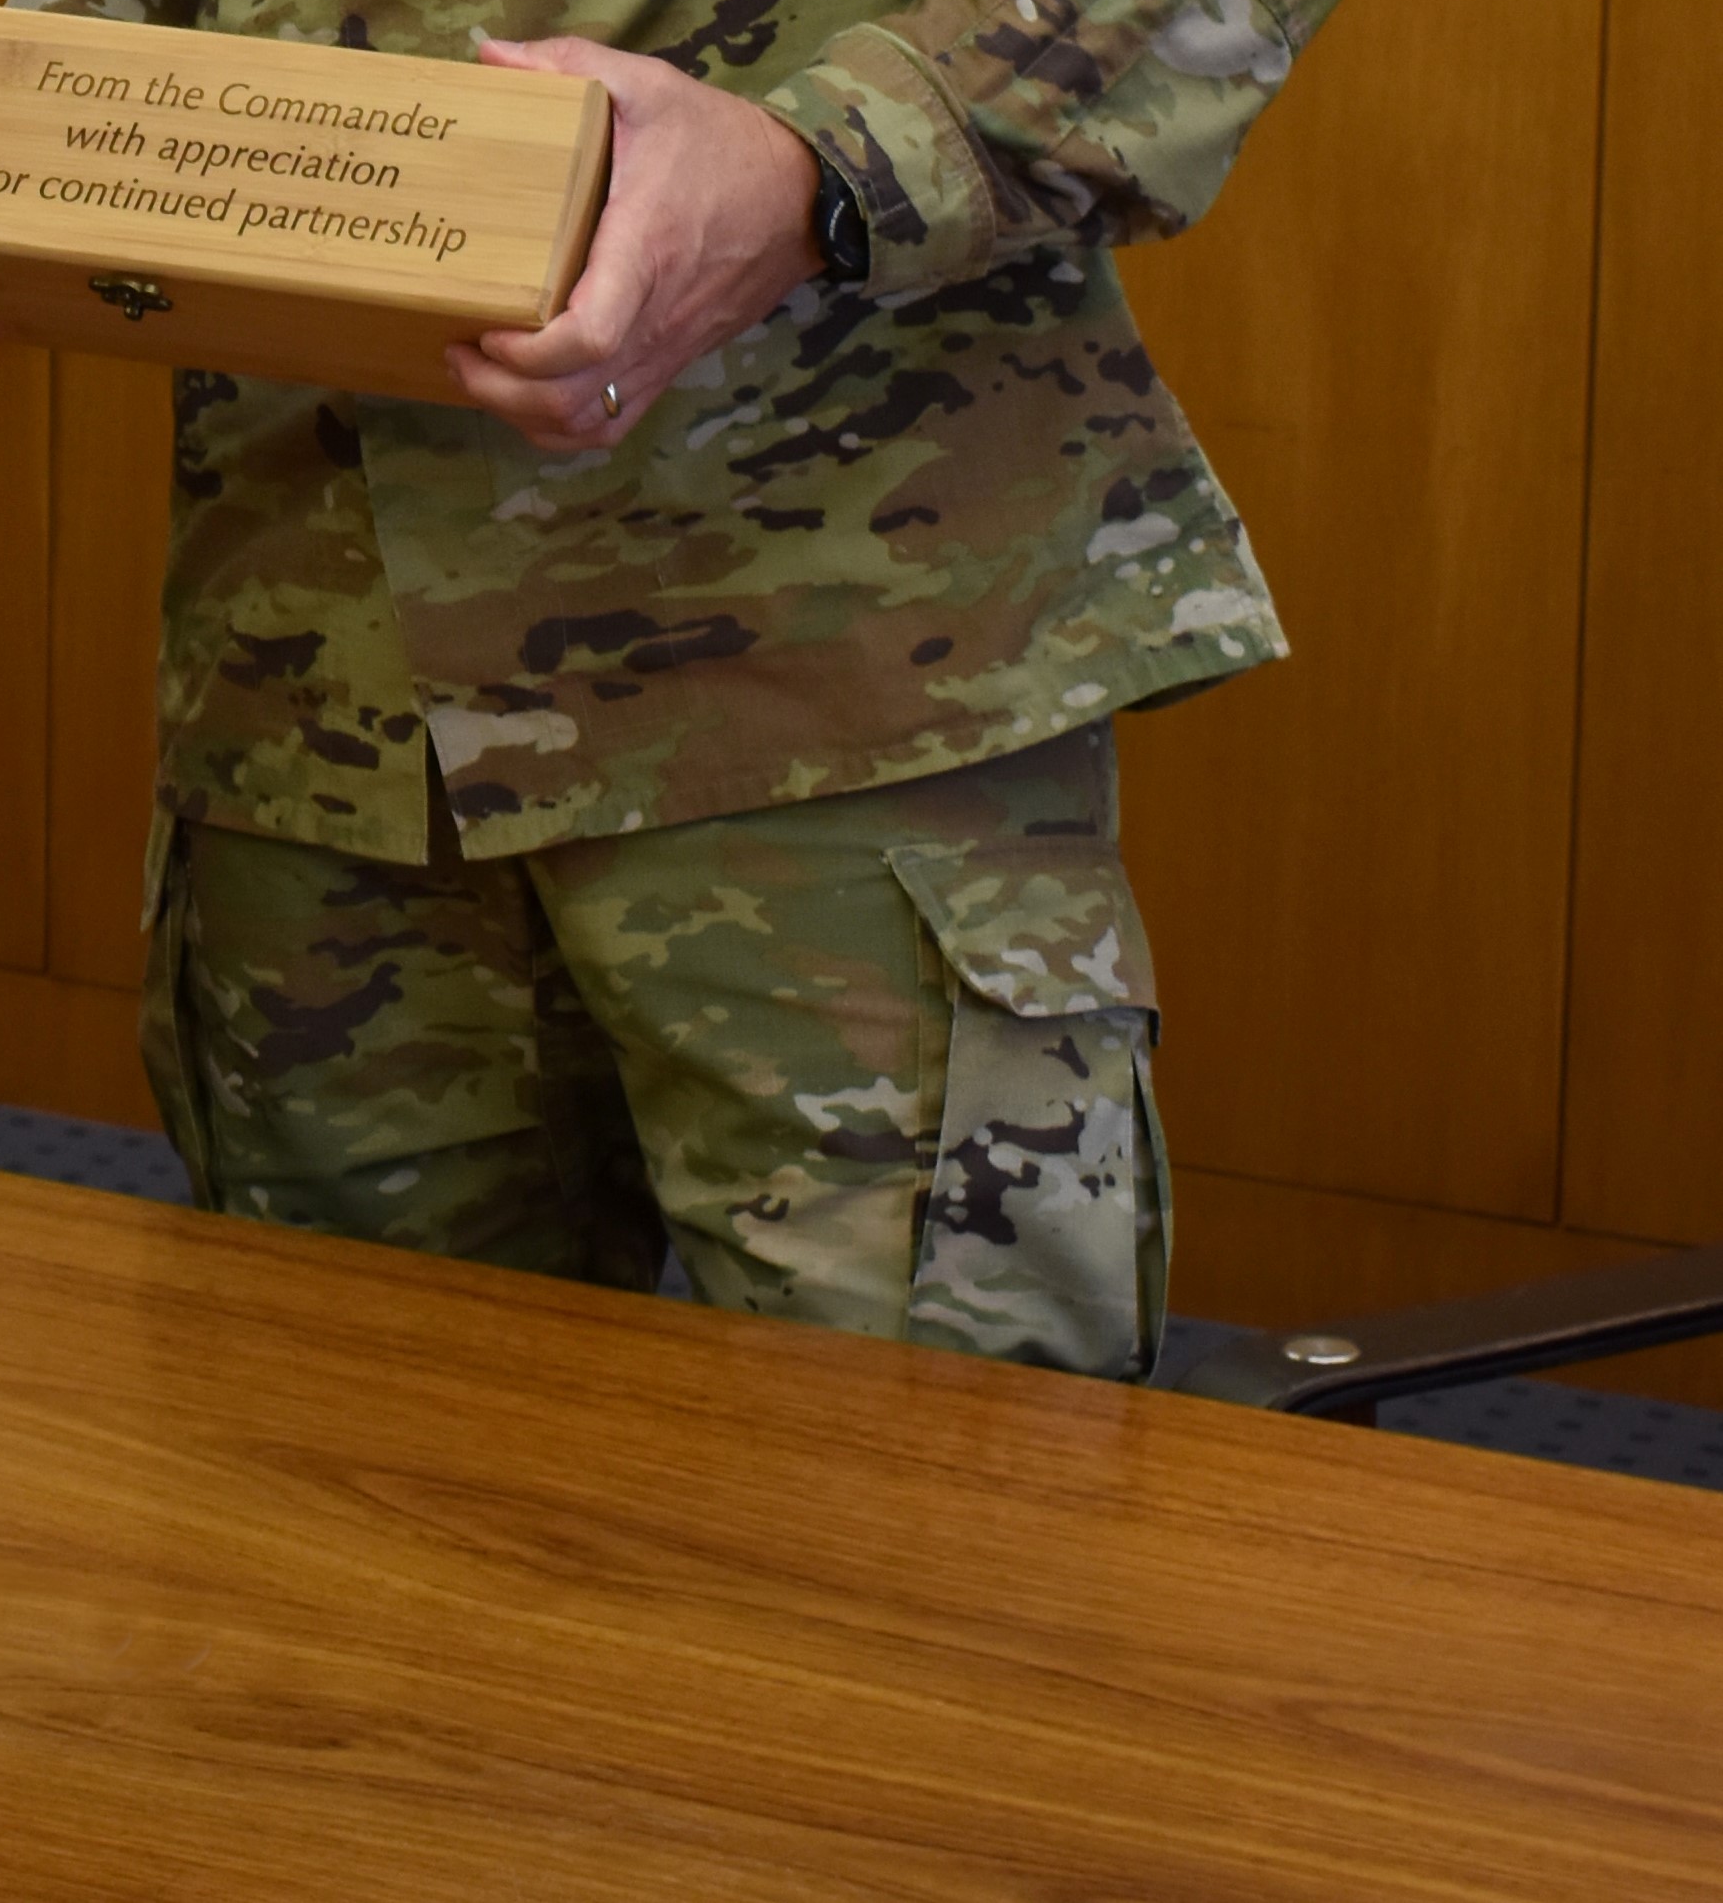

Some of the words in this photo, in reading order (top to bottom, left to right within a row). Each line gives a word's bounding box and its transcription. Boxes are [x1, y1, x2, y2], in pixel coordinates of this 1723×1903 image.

[36, 60, 132, 102] From
[143, 72, 206, 111] the
[217, 81, 459, 142] Commander
[64, 120, 147, 157] with
[156, 135, 402, 189] appreciation
[38, 172, 237, 223] continued
[236, 199, 468, 262] partnership
